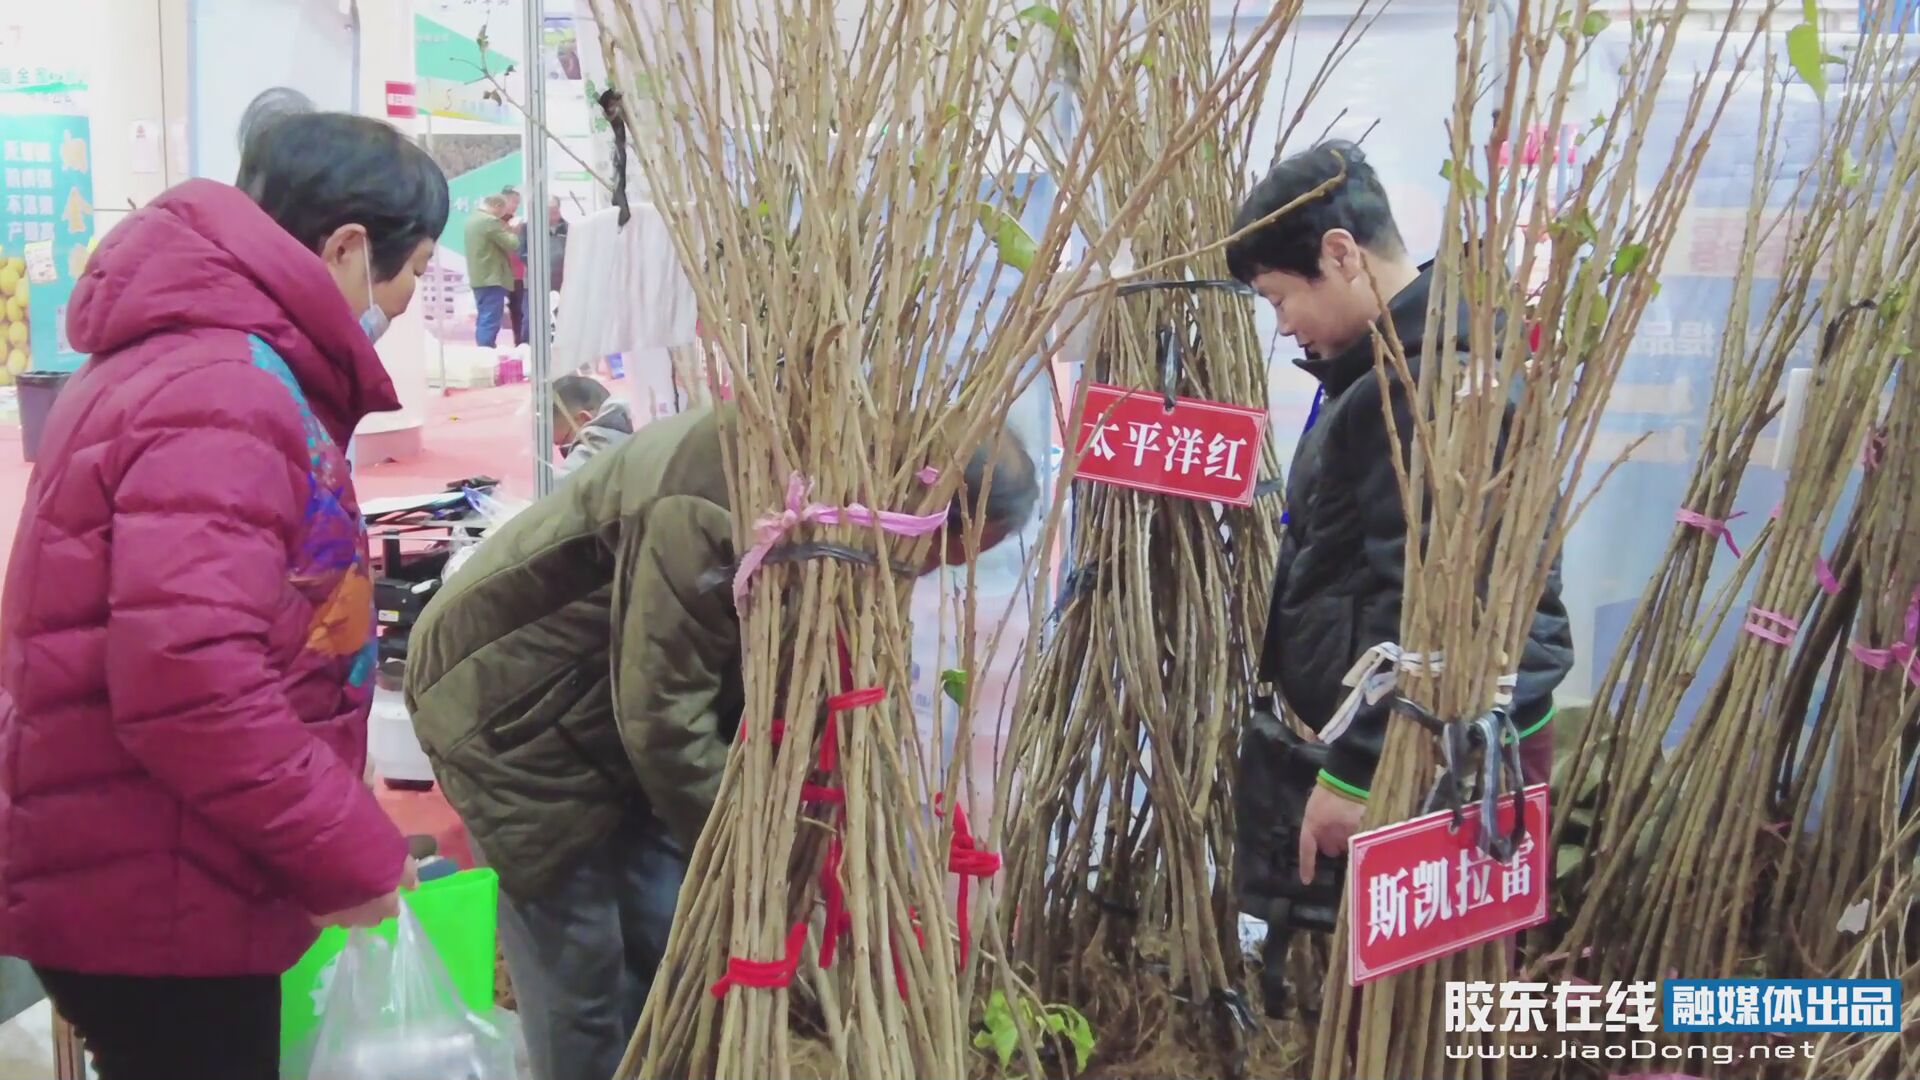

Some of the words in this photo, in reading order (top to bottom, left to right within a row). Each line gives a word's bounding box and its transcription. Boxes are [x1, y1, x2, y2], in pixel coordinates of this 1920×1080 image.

[1083, 411, 1248, 481] 太平洋红
[1367, 830, 1535, 947] 斯凯拉雷
